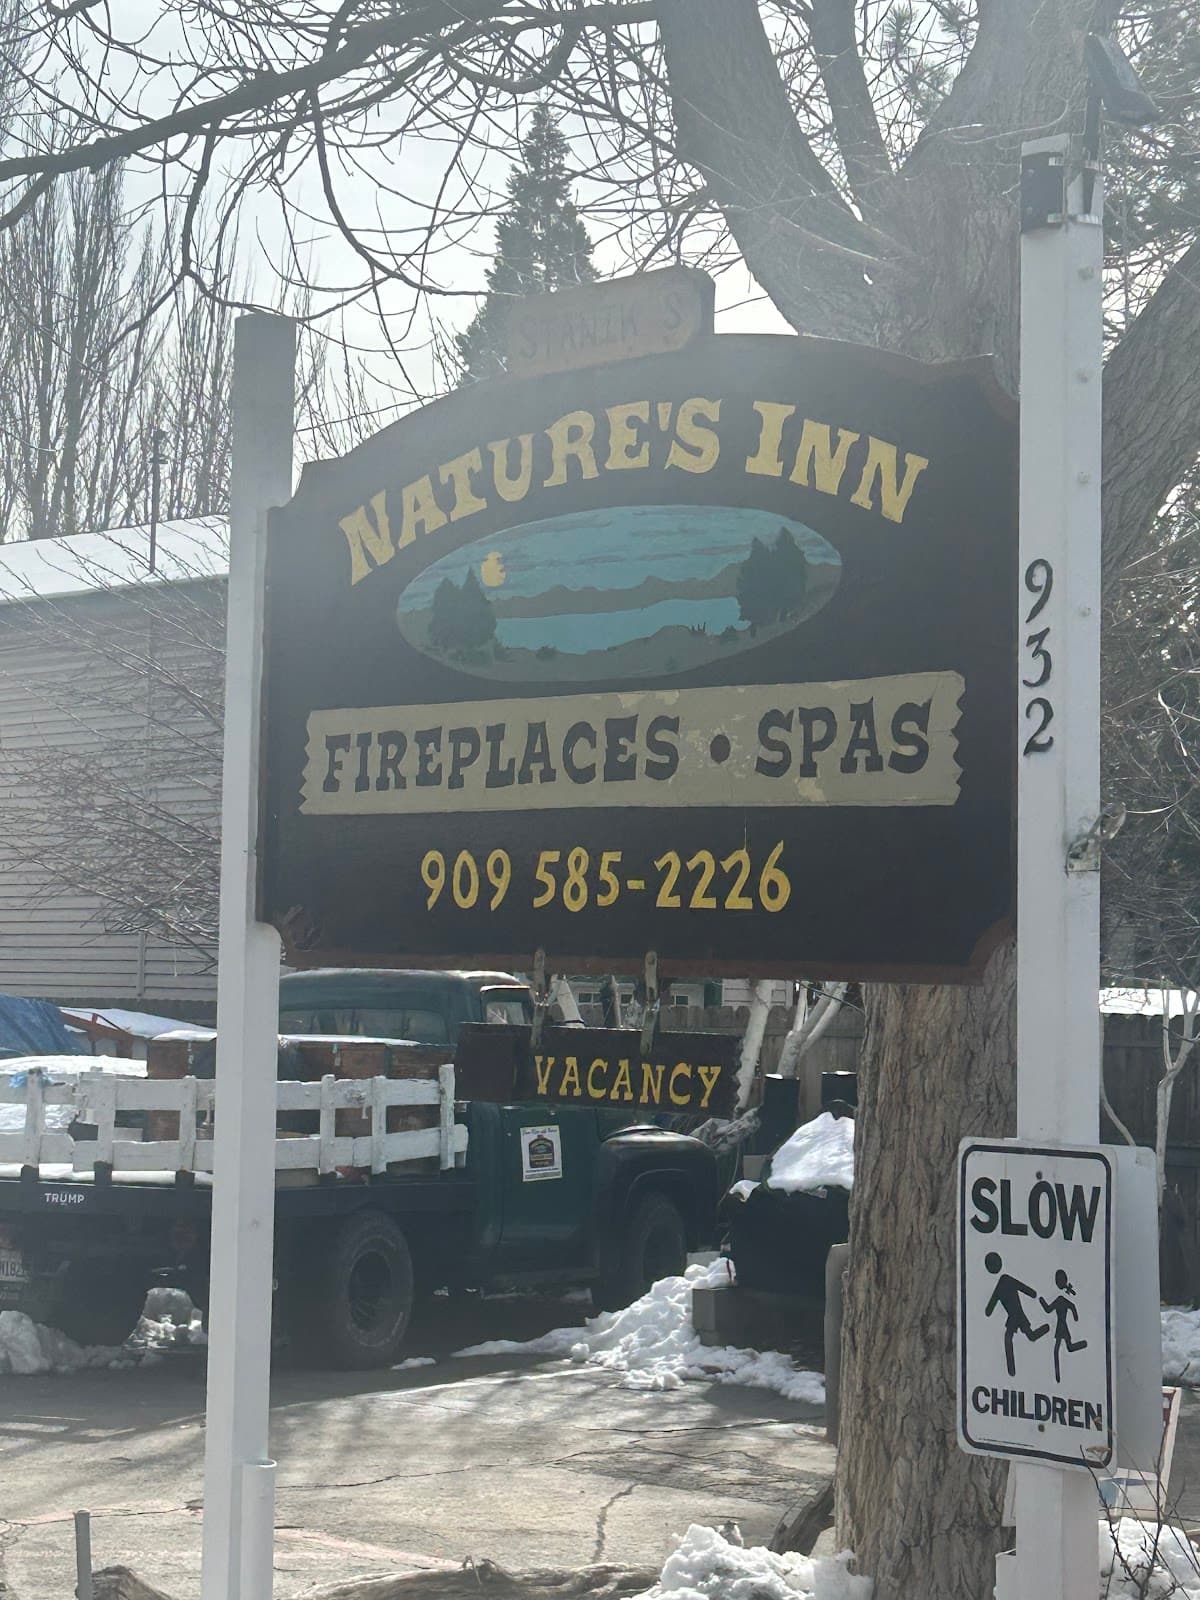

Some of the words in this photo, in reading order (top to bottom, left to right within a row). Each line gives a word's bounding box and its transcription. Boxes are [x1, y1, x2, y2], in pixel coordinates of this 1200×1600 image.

[339, 398, 722, 586] NATURE'S
[744, 400, 929, 523] INN
[1022, 558, 1054, 757] 932
[322, 713, 681, 793] FIREPLACES
[754, 696, 933, 779] SPAS
[420, 848, 512, 912] 909
[532, 840, 792, 913] 585-2226
[534, 1055, 722, 1108] VACANCY
[44, 1192, 85, 1204] TRUMP
[969, 1176, 1102, 1243] SLOW
[971, 1385, 1103, 1432] CHILDREN
